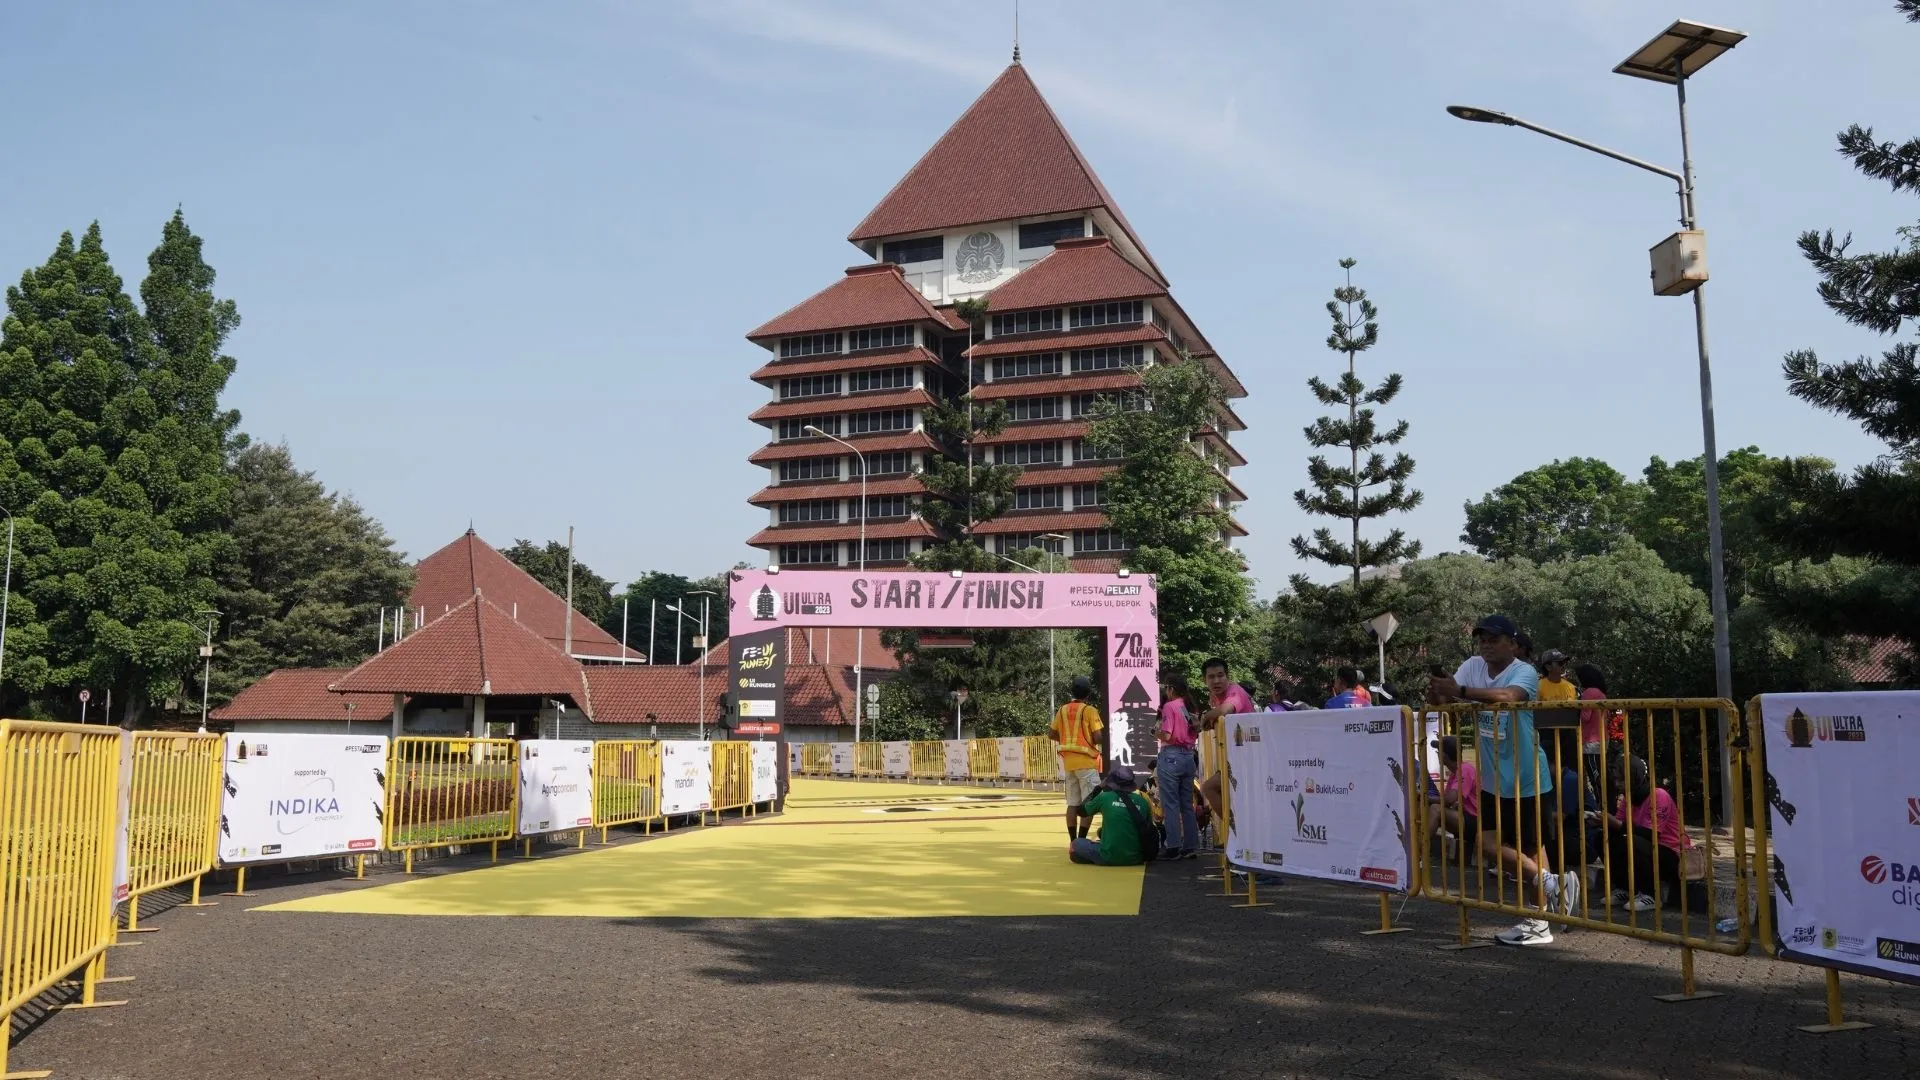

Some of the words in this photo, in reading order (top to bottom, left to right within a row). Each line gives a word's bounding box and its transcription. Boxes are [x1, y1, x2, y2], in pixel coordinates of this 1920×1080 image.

[850, 578, 1044, 609] START/FINISH
[784, 592, 799, 614] UI
[801, 592, 831, 604] ULTRA
[1104, 600, 1114, 608] UI,
[815, 606, 830, 614] 2023
[1114, 658, 1153, 668] CHALLENGE
[1816, 716, 1833, 741] UI
[1833, 715, 1864, 730] ULTRA
[1288, 757, 1317, 768] supported
[1318, 758, 1325, 768] by
[269, 798, 339, 816] INDIKA
[1894, 943, 1904, 951] UI
[1894, 951, 1920, 961] RUNN
